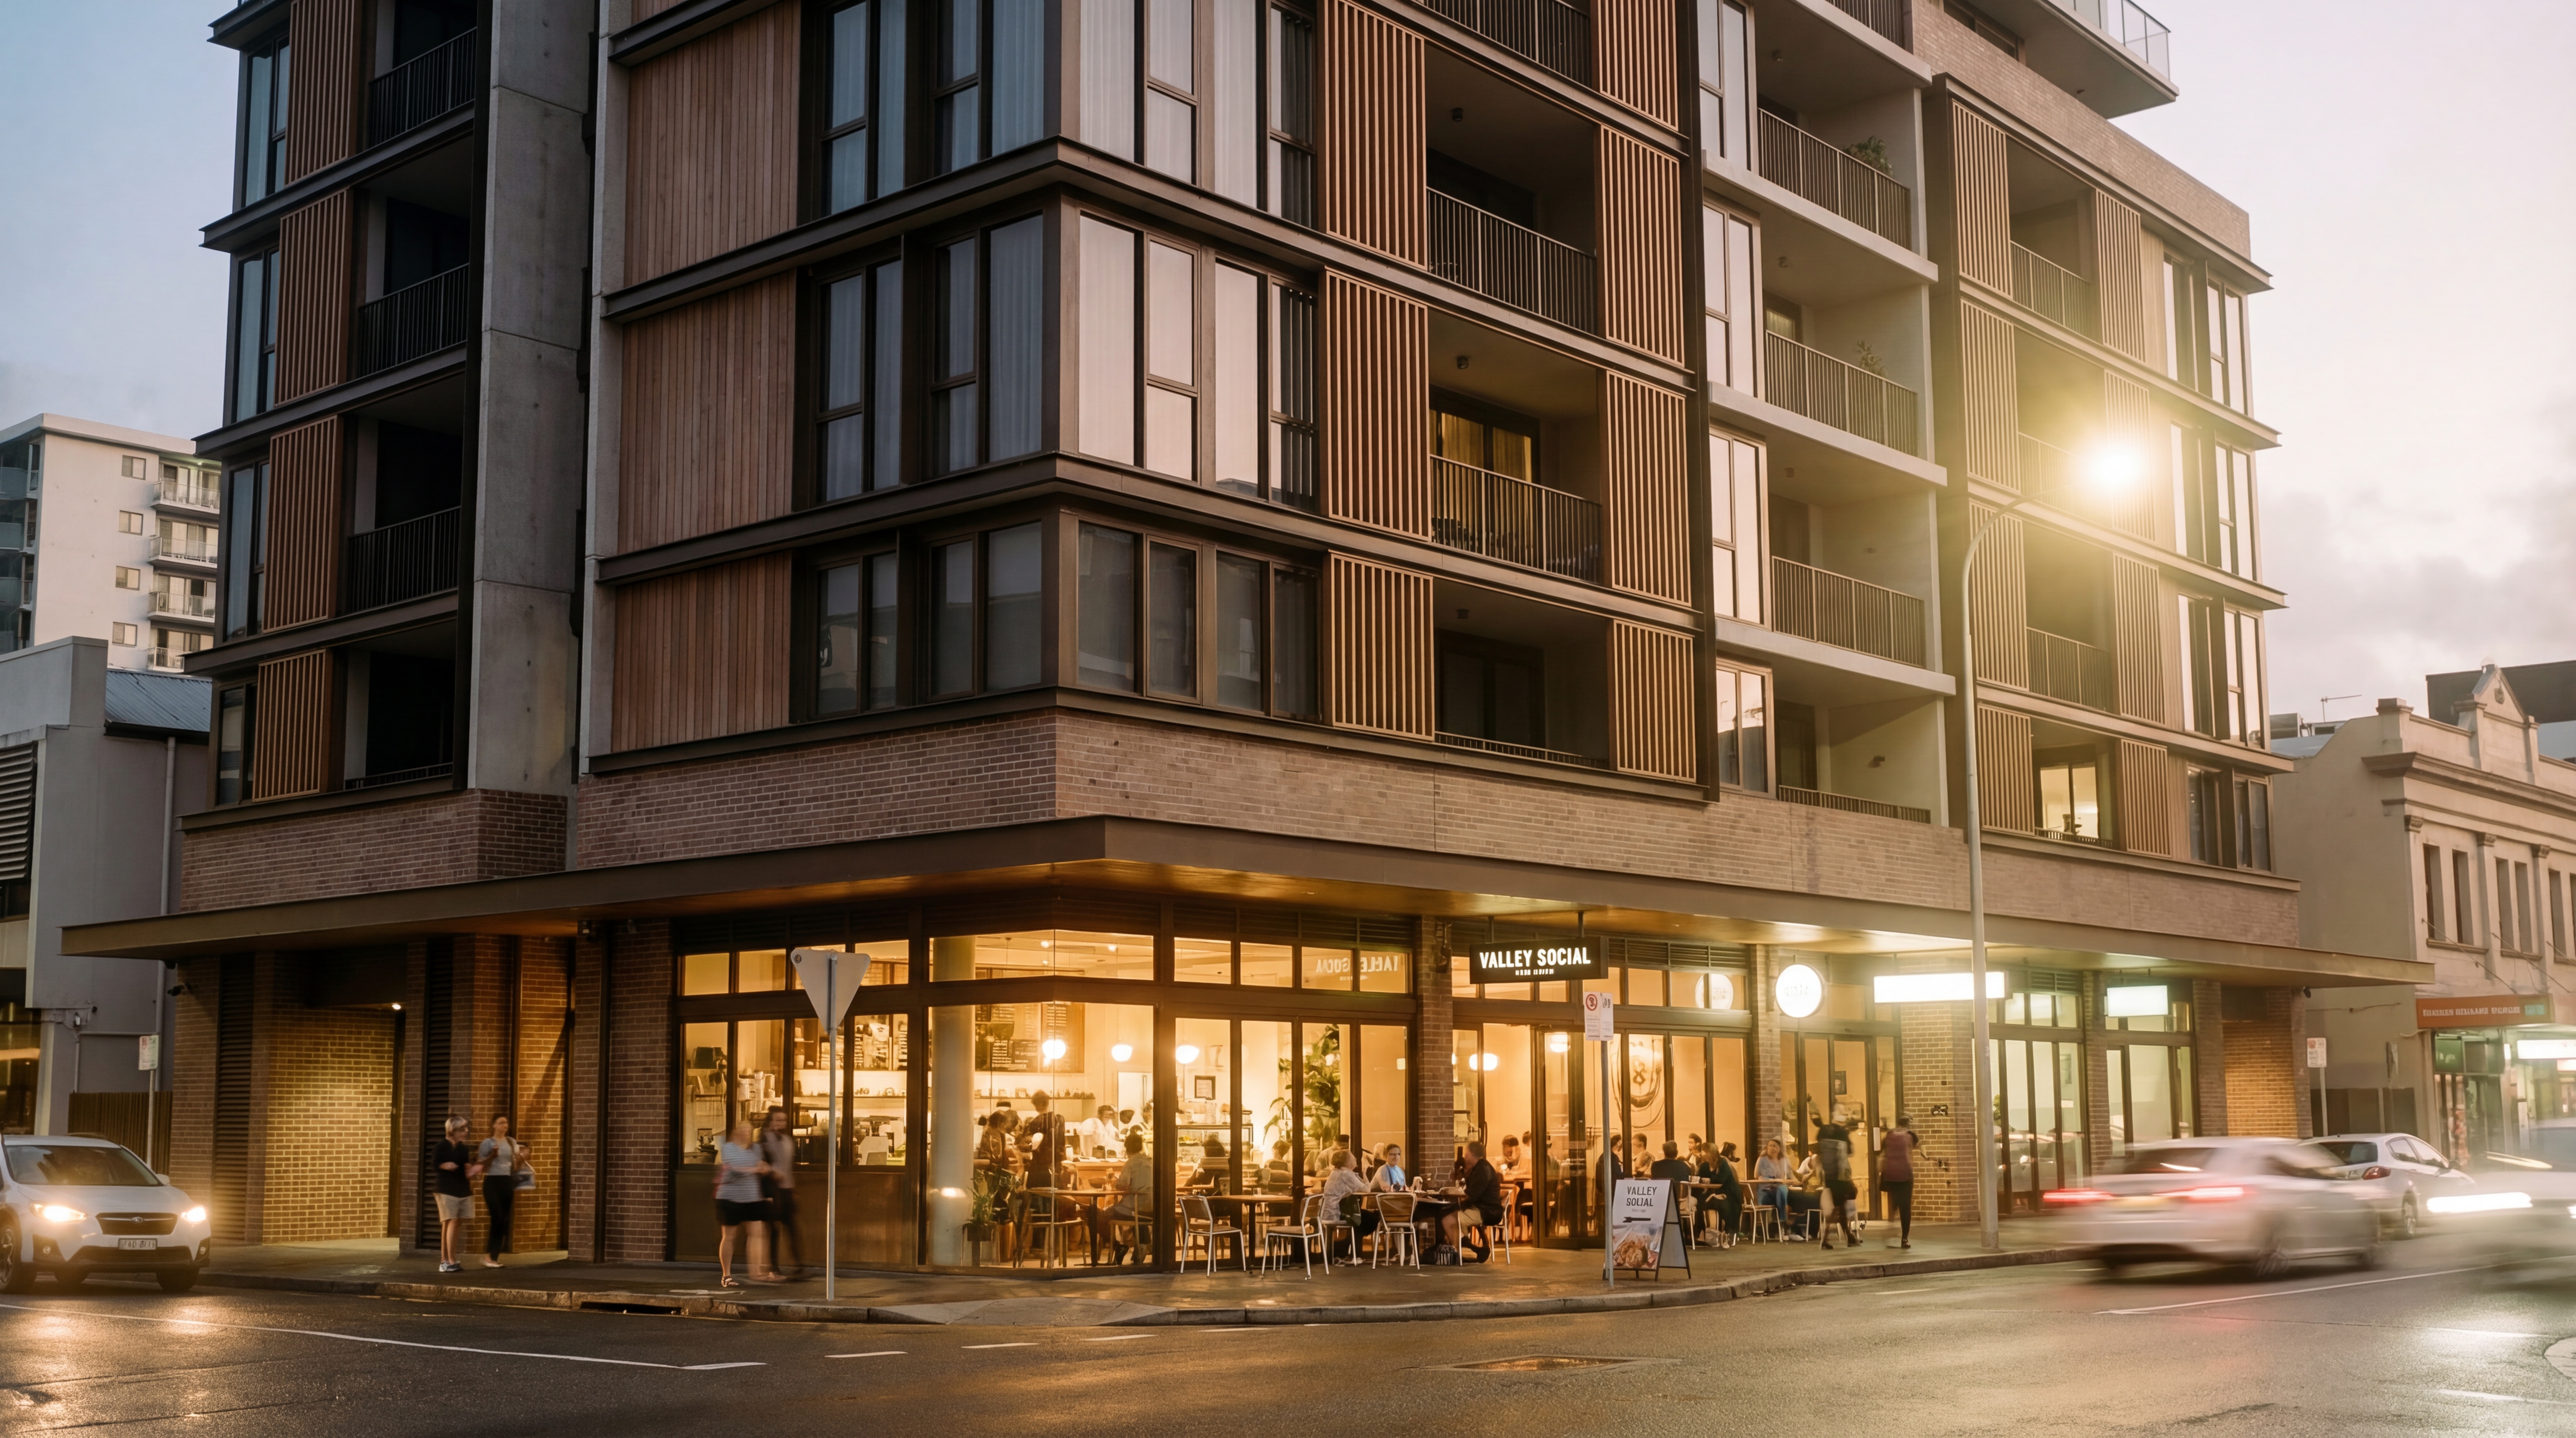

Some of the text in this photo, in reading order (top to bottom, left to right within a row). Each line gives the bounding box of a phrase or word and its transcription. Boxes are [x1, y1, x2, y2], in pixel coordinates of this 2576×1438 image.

[1479, 947, 1591, 968] VALLEY SOCIAL
[1627, 1186, 1657, 1195] VALLEY
